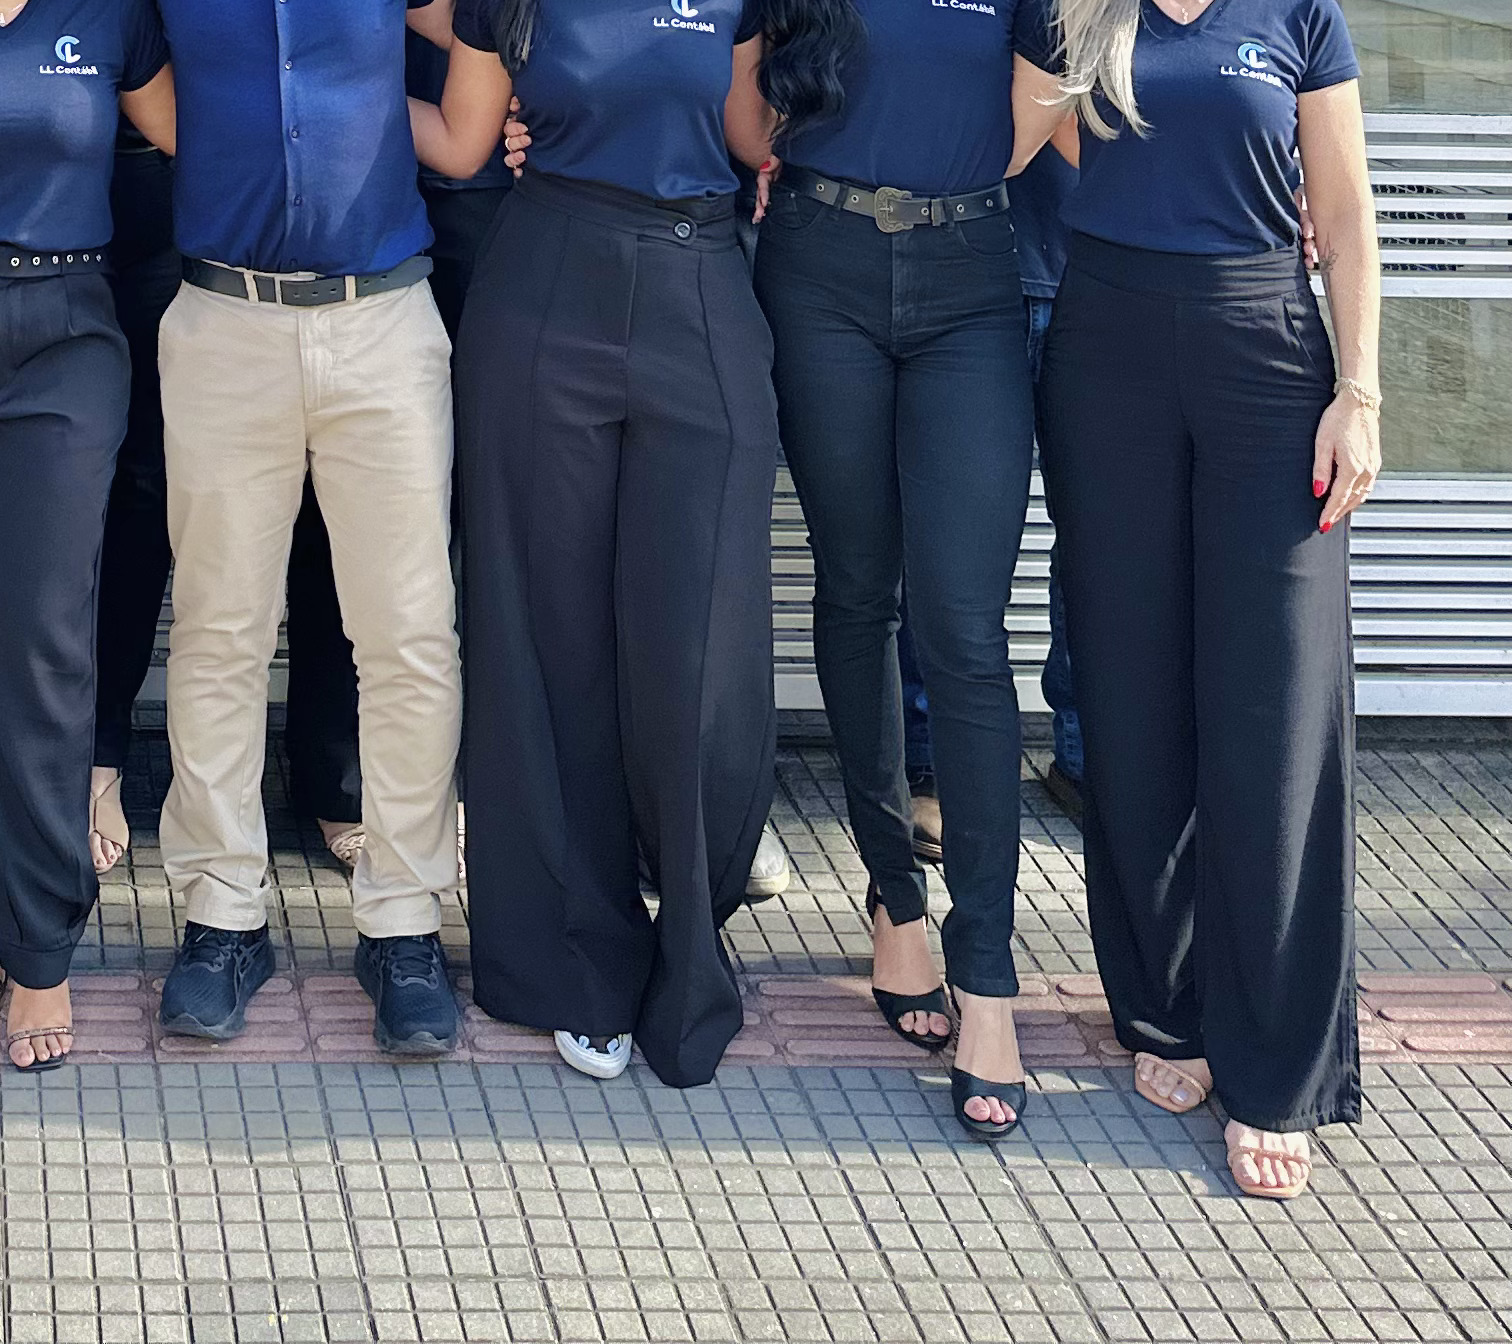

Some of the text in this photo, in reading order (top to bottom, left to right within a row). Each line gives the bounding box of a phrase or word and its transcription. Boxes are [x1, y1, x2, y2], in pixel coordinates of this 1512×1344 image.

[653, 17, 670, 27] LL
[39, 65, 55, 74] LL
[1220, 65, 1238, 76] LL
